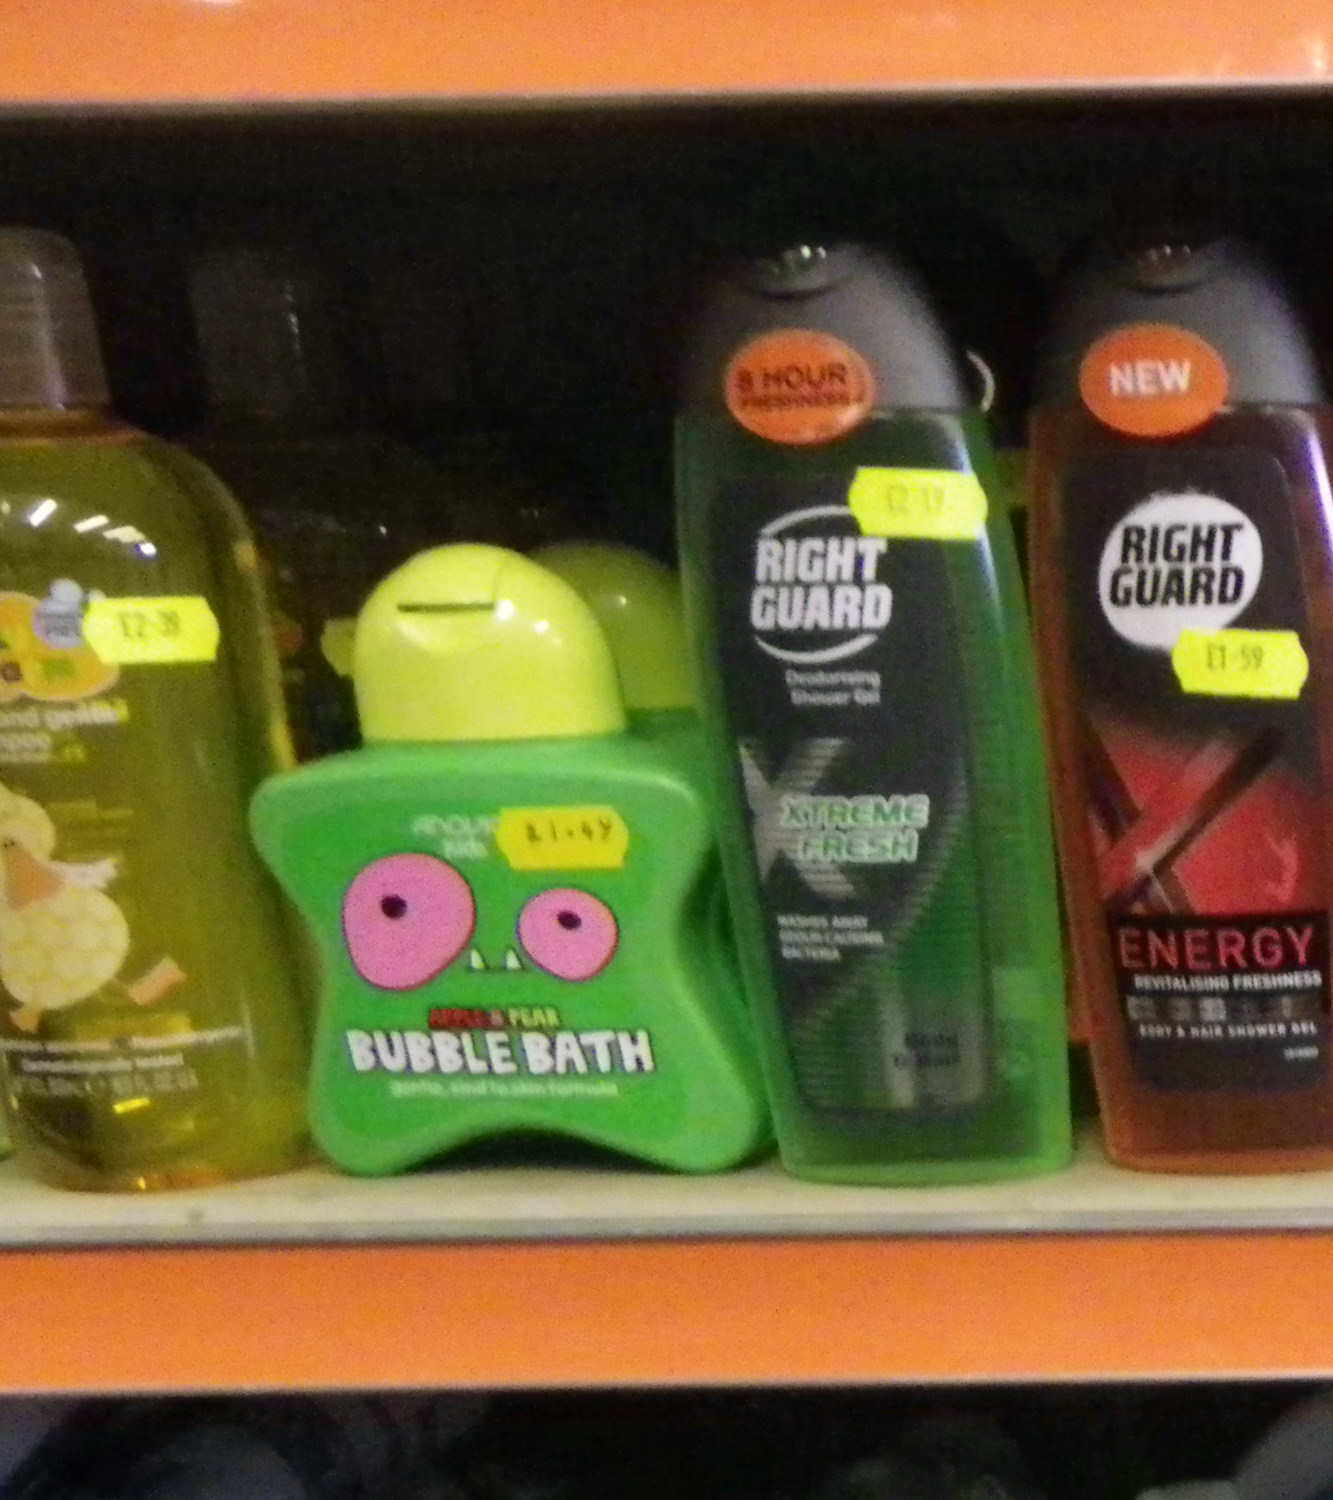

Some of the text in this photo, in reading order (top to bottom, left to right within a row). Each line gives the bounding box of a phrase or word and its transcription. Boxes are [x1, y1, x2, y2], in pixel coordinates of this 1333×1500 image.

[763, 362, 847, 389] HOUR
[1109, 360, 1191, 396] NEW
[756, 537, 889, 583] RIGHT
[1120, 522, 1244, 565] RIGHT
[751, 584, 894, 631] GUARD
[1109, 566, 1245, 608] GUARD
[1119, 926, 1314, 970] ENERGY
[345, 1029, 654, 1074] BUBBLE BATH
